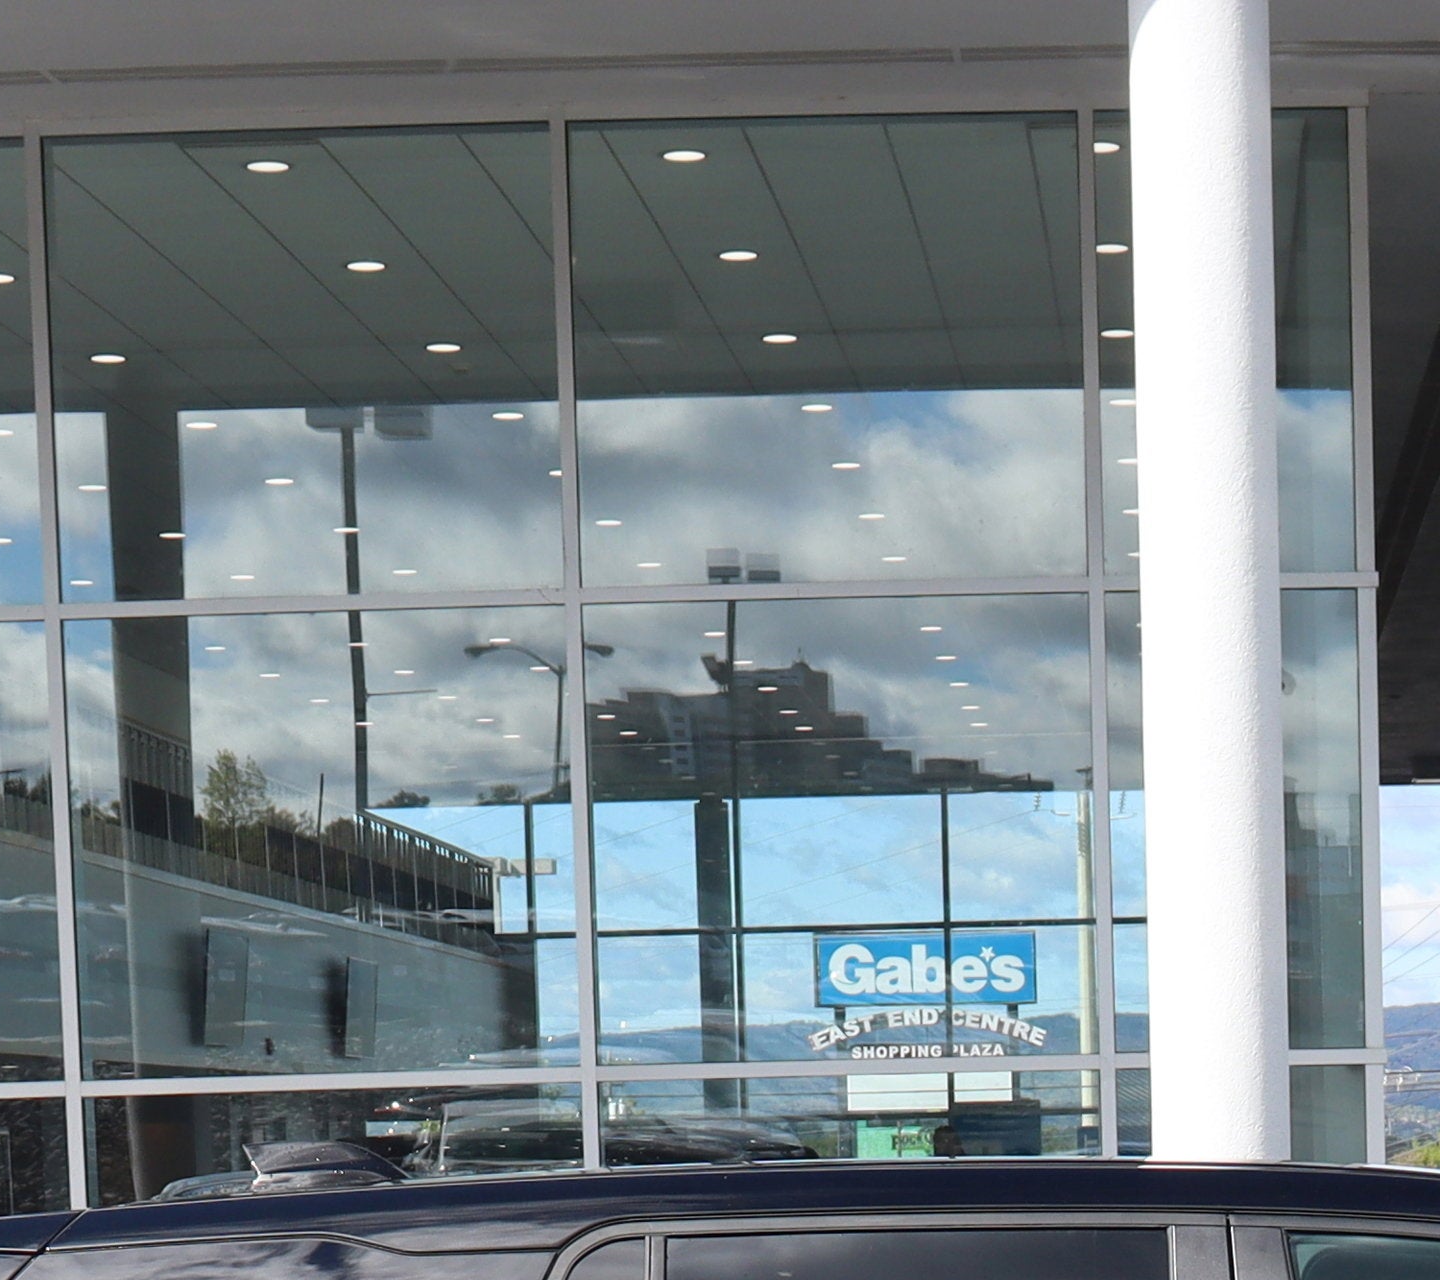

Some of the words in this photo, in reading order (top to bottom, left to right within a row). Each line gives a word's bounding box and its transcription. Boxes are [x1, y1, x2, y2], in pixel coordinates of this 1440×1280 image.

[828, 943, 1026, 995] Gabe's
[810, 1014, 875, 1050] EAST
[887, 1007, 939, 1028] END
[952, 1010, 1047, 1047] CENTRE
[851, 1044, 943, 1060] SHOPPING
